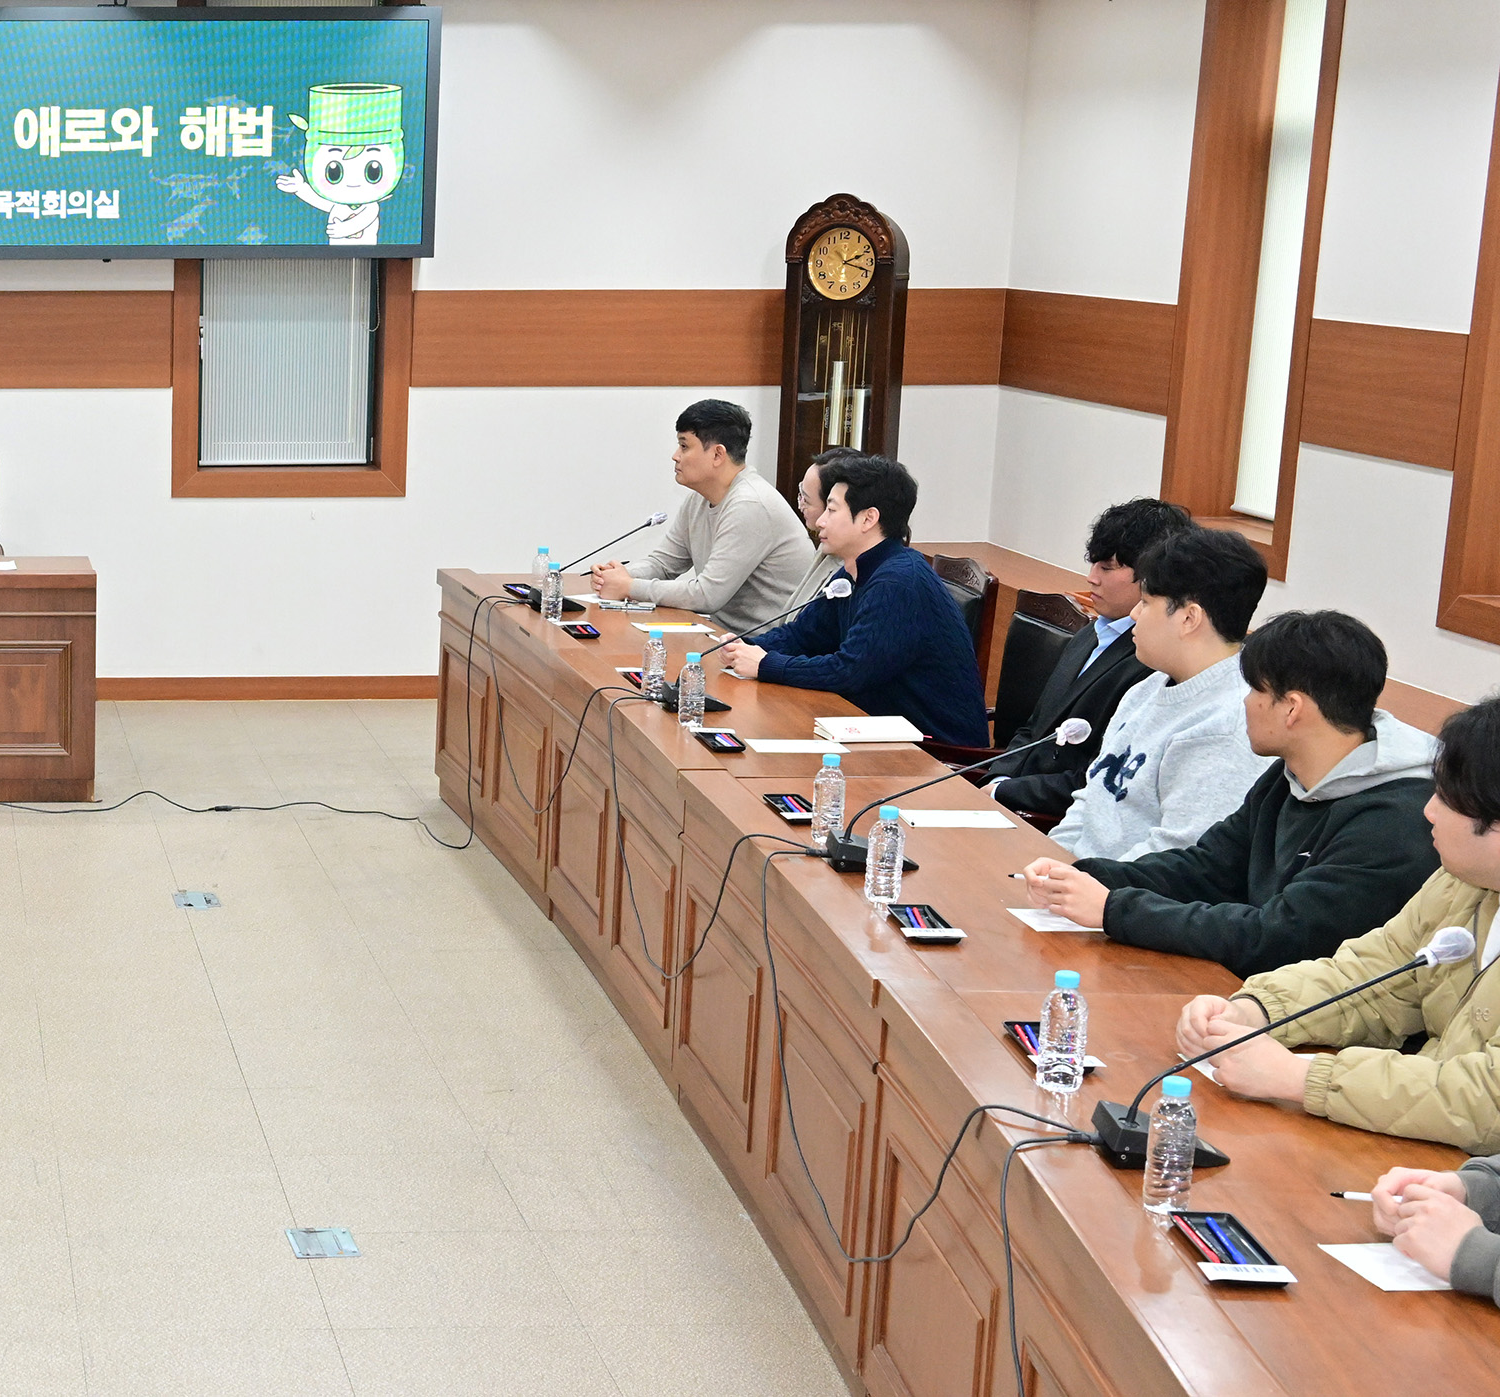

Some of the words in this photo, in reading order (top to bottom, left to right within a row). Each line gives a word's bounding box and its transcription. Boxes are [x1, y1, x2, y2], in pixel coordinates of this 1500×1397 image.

[13, 105, 159, 157] 애로와
[179, 105, 274, 157] 해법
[828, 236, 836, 244] 11
[840, 231, 850, 240] 12
[857, 235, 861, 243] 1
[819, 246, 828, 255] 10
[863, 244, 871, 253] 2
[815, 259, 823, 268] 9
[866, 258, 874, 266] 3
[818, 271, 826, 280] 8
[861, 269, 868, 278] 4
[827, 281, 835, 289] 7
[840, 285, 847, 293] 6
[853, 281, 860, 289] 5
